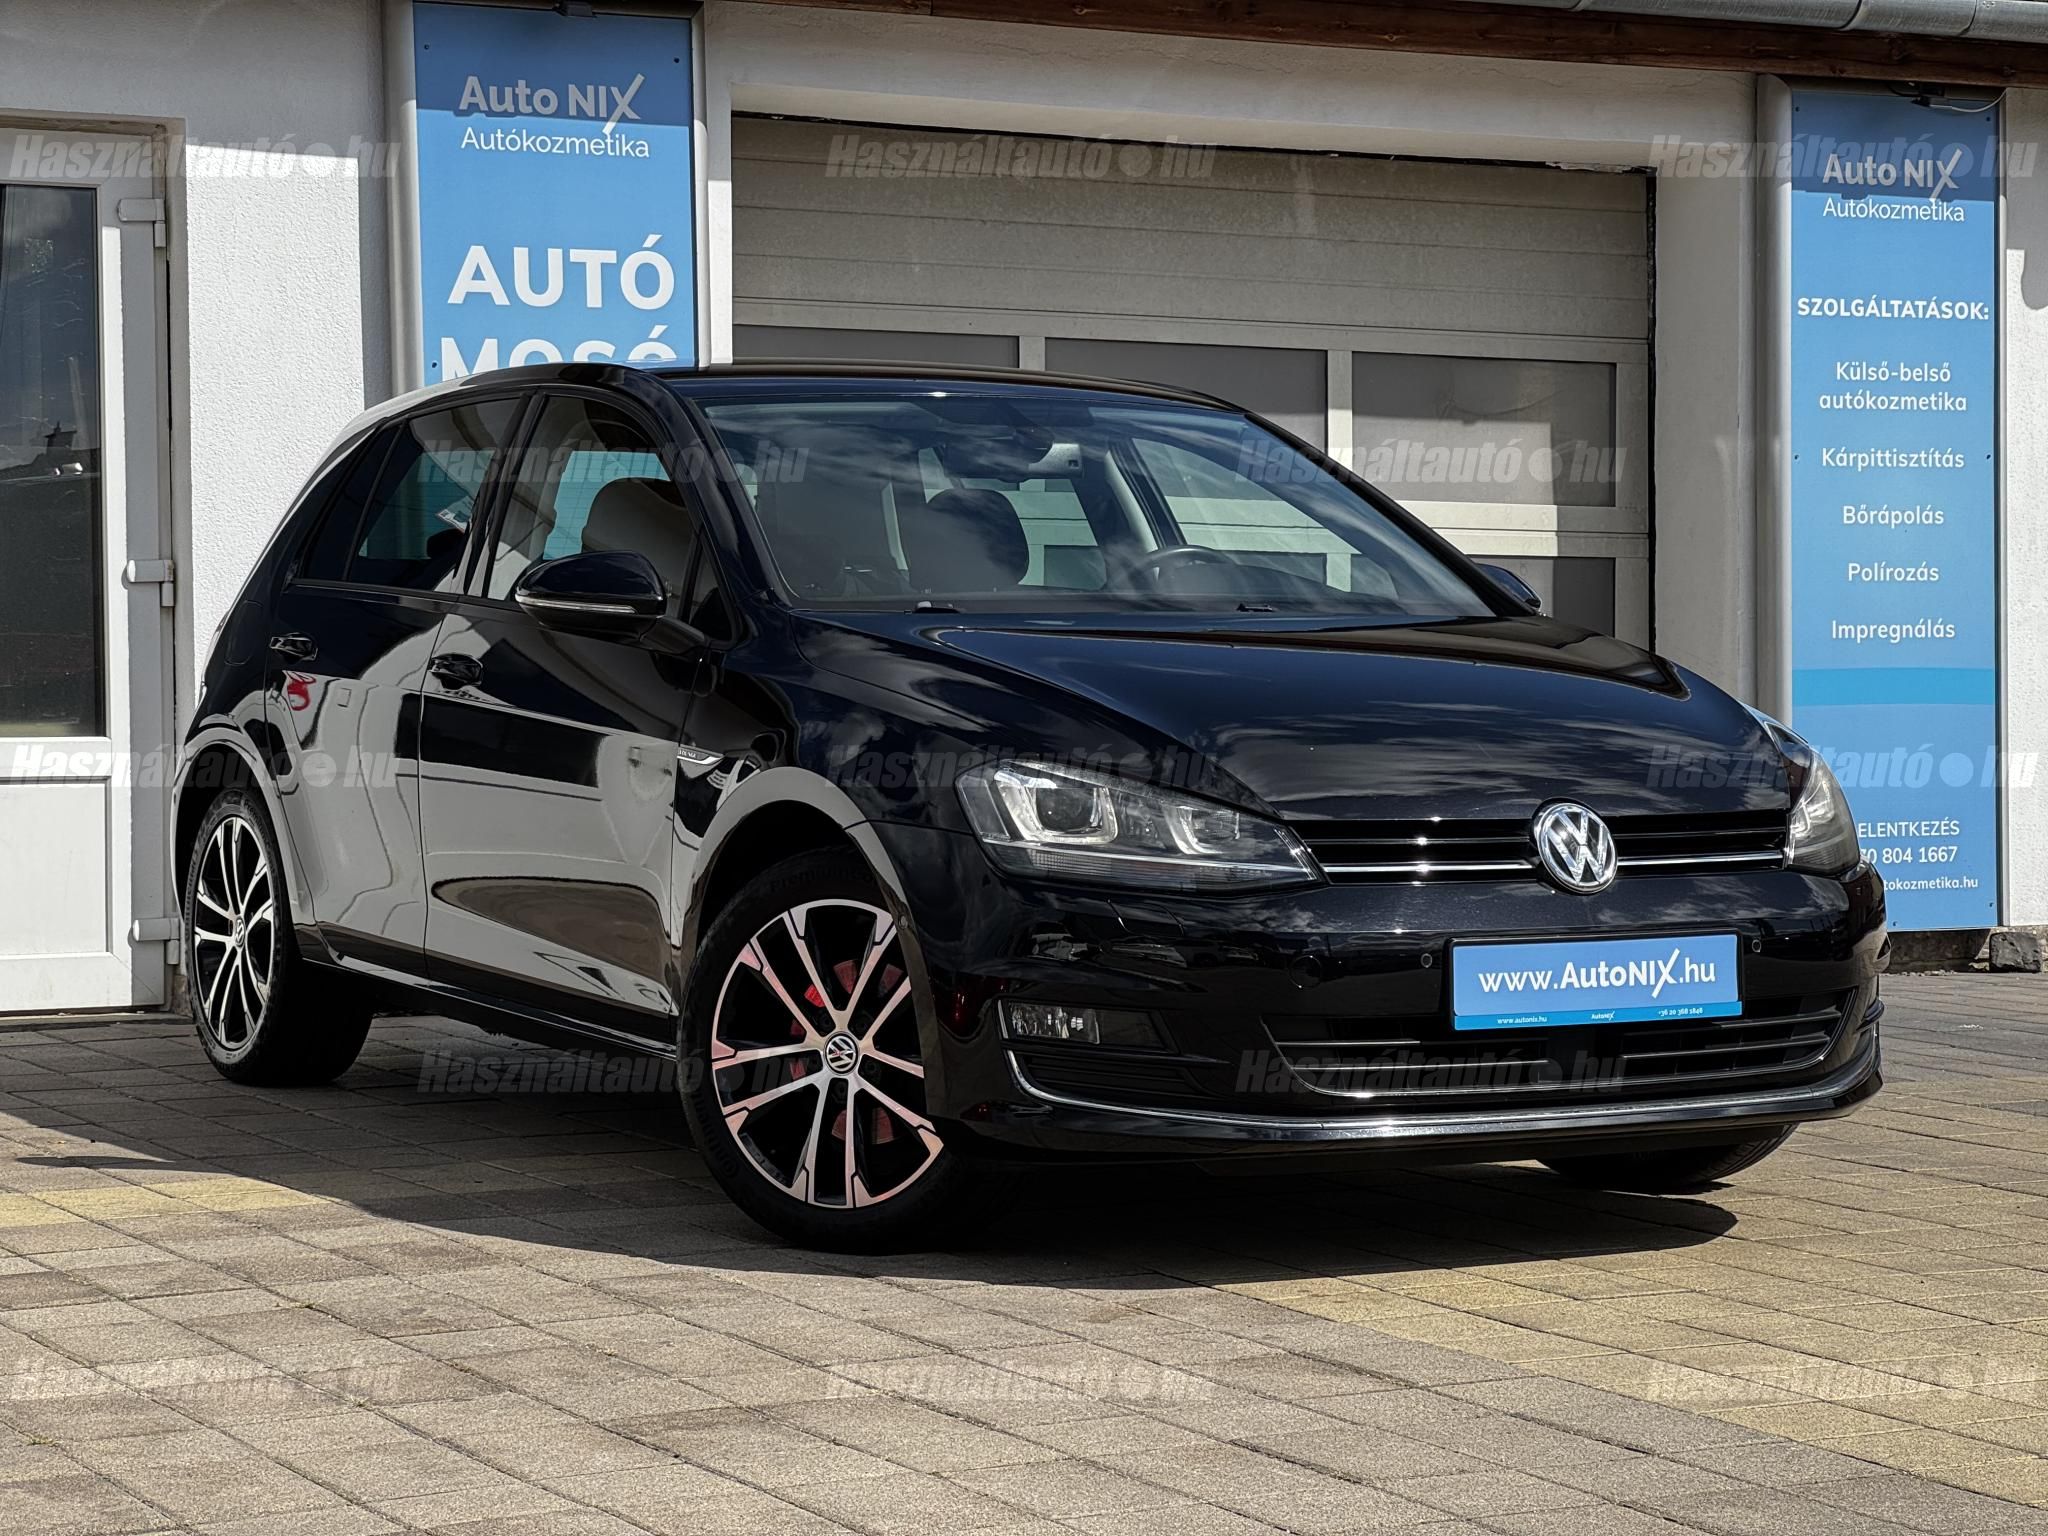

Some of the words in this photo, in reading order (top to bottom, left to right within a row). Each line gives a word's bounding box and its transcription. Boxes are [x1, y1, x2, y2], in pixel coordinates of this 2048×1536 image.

[459, 75, 558, 114] Auto
[569, 74, 646, 136] NIX
[461, 125, 650, 158] Autókozmetika
[1823, 153, 1897, 186] Auto
[1904, 149, 1963, 199] NIX
[1823, 197, 1965, 222] Autókozmetika
[447, 233, 675, 310] AUTÓ
[1797, 295, 1989, 320] SZOLGÁLTATÁSOK:
[1836, 361, 1951, 382] Külső-belső
[1819, 389, 1967, 411] autókozmetika
[1822, 446, 1965, 472] Kárpittisztítás
[1843, 504, 1944, 528] Bőrápolás
[1848, 562, 1940, 582] Polírozás
[1832, 618, 1956, 643] Impregnálás
[1857, 817, 1960, 838] ELENTKEZÉS
[1882, 847, 1913, 864] 804
[1919, 846, 1958, 863] 1667
[1884, 876, 1978, 892] tokozmetika.hu
[1479, 948, 1716, 999] www.AutoNIX.hu
